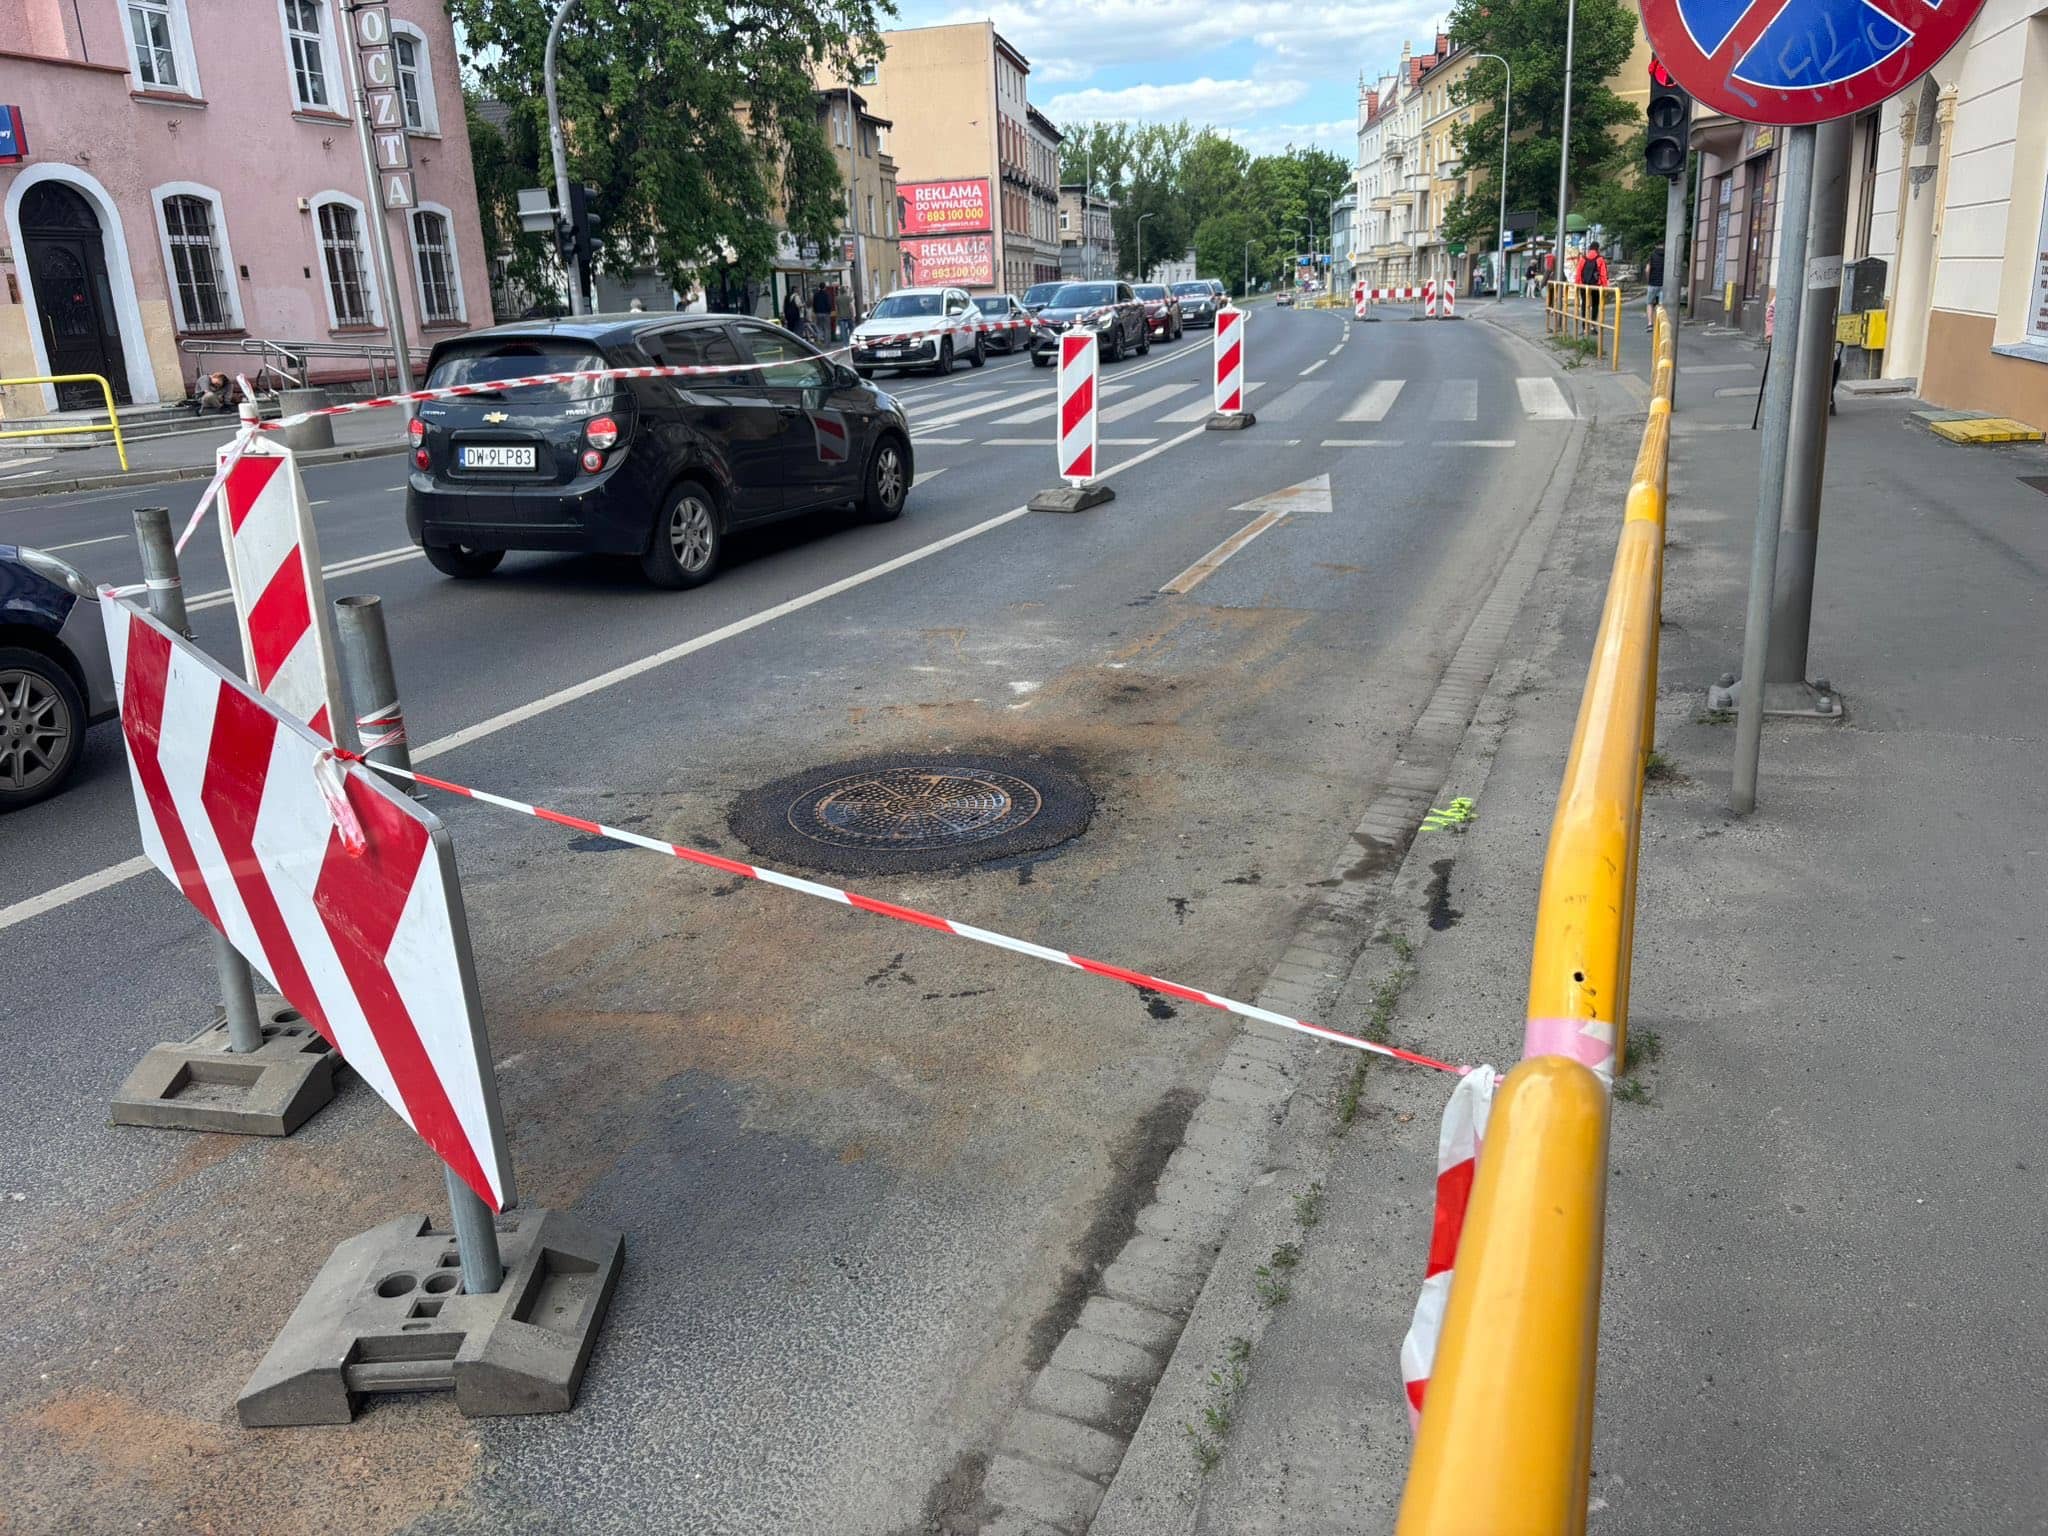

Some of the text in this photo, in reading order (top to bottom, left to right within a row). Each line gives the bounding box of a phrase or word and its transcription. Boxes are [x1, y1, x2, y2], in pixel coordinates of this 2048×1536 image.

[361, 10, 410, 206] OCZTA
[915, 185, 982, 200] REKLAMA
[916, 198, 983, 211] DO WYNAJĘCIA
[965, 207, 984, 219] 000
[921, 241, 988, 257] REKLAMA
[922, 255, 988, 267] DO WYNAJĘCIA
[467, 449, 531, 465] DW 9LP83
